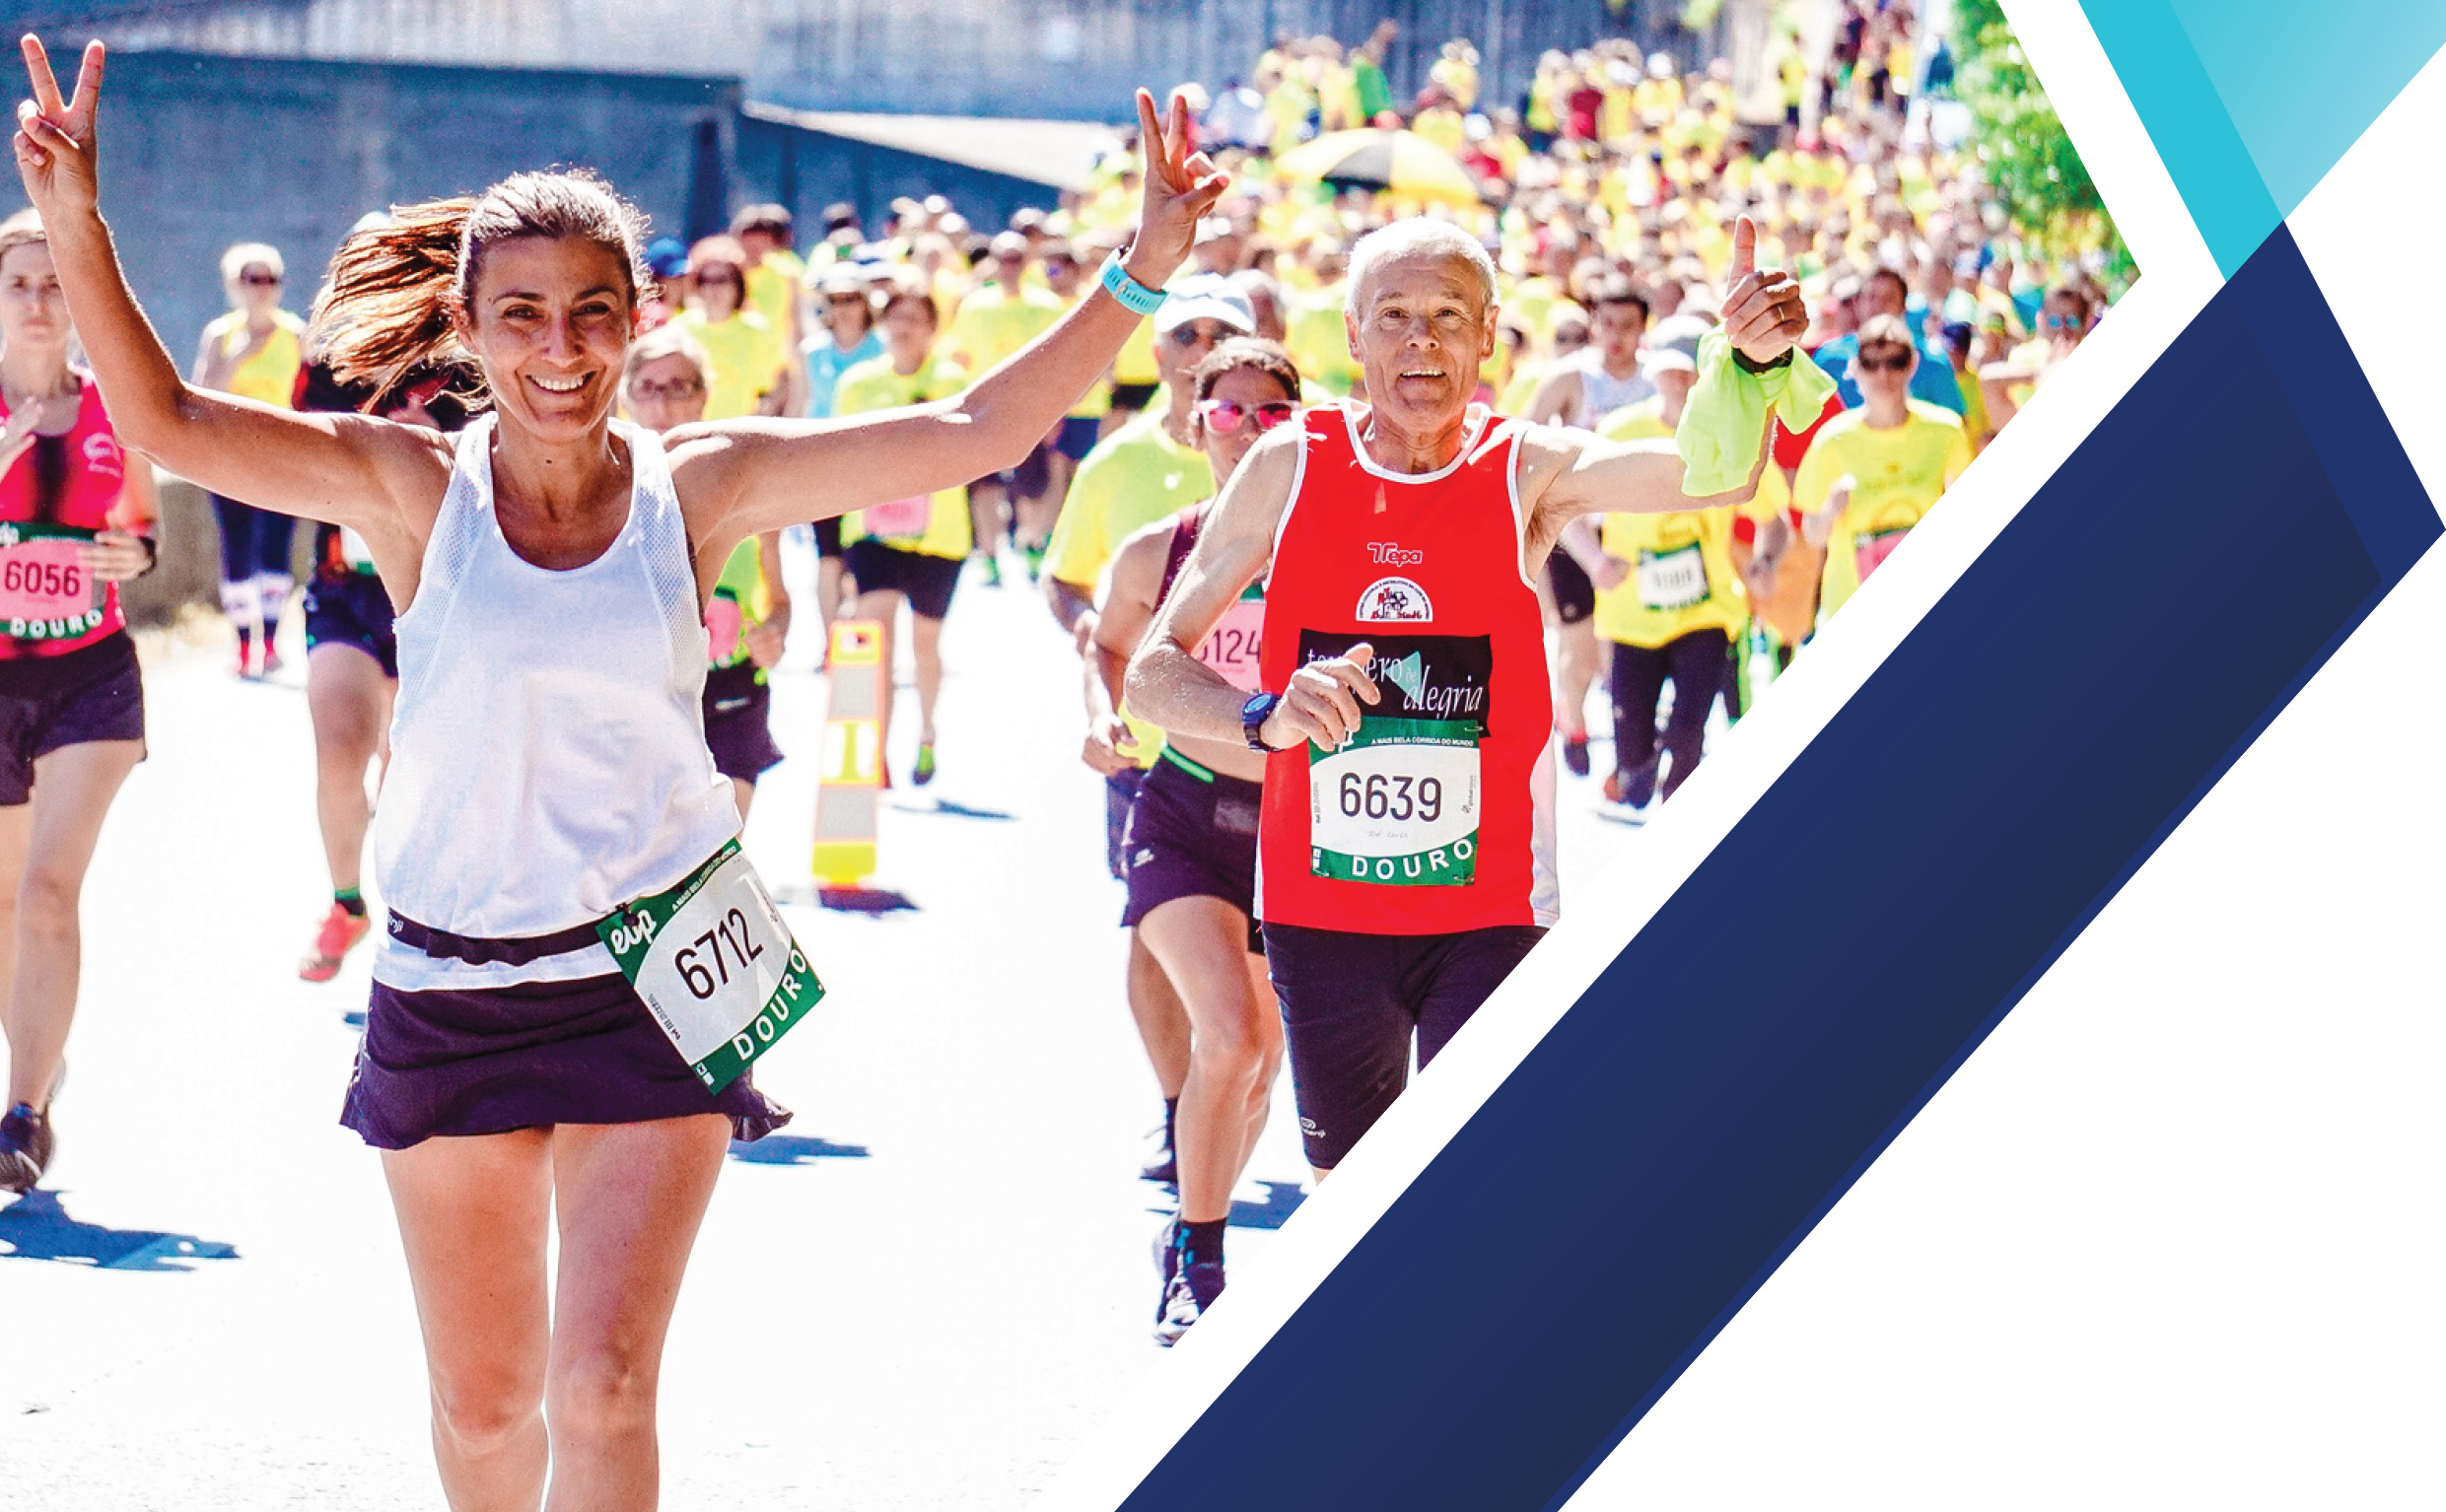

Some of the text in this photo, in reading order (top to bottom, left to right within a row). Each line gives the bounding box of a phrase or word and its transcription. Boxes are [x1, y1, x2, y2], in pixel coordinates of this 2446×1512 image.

[5, 560, 80, 597] 6056
[10, 608, 103, 638] DOURO
[1403, 663, 1484, 720] alegria
[1340, 772, 1442, 822] 6639
[1352, 838, 1473, 880] DOURO
[674, 908, 764, 999] 6712
[732, 948, 806, 1061] DOURO
